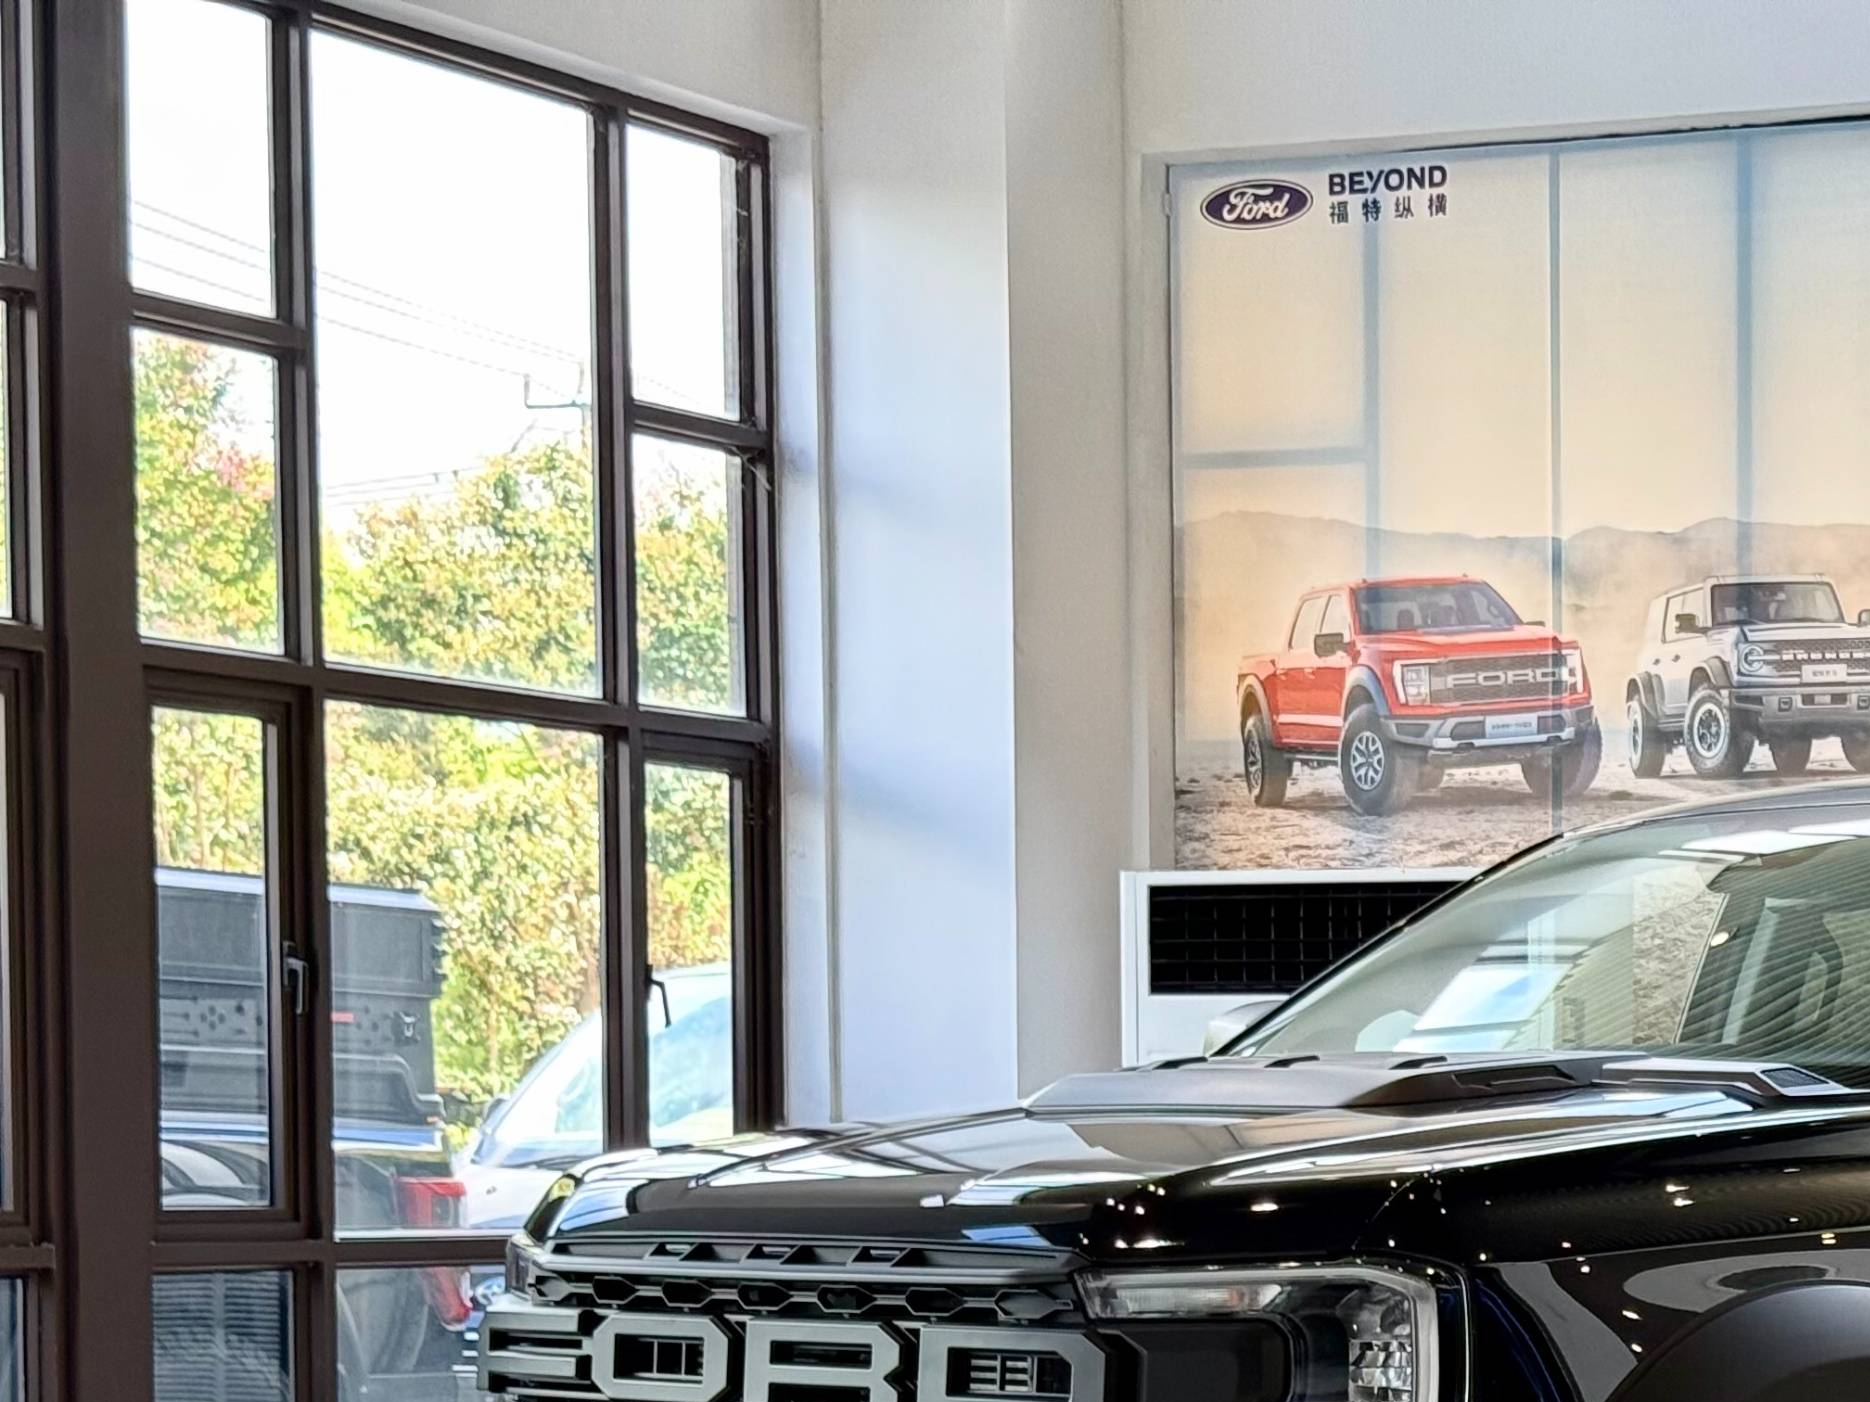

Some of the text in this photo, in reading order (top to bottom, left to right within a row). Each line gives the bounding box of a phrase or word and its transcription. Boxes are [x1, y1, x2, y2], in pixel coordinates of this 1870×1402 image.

[1328, 164, 1448, 196] BEYOND
[1219, 185, 1293, 224] Ford
[1328, 193, 1448, 225] 福特纵横
[1445, 668, 1562, 690] FORD
